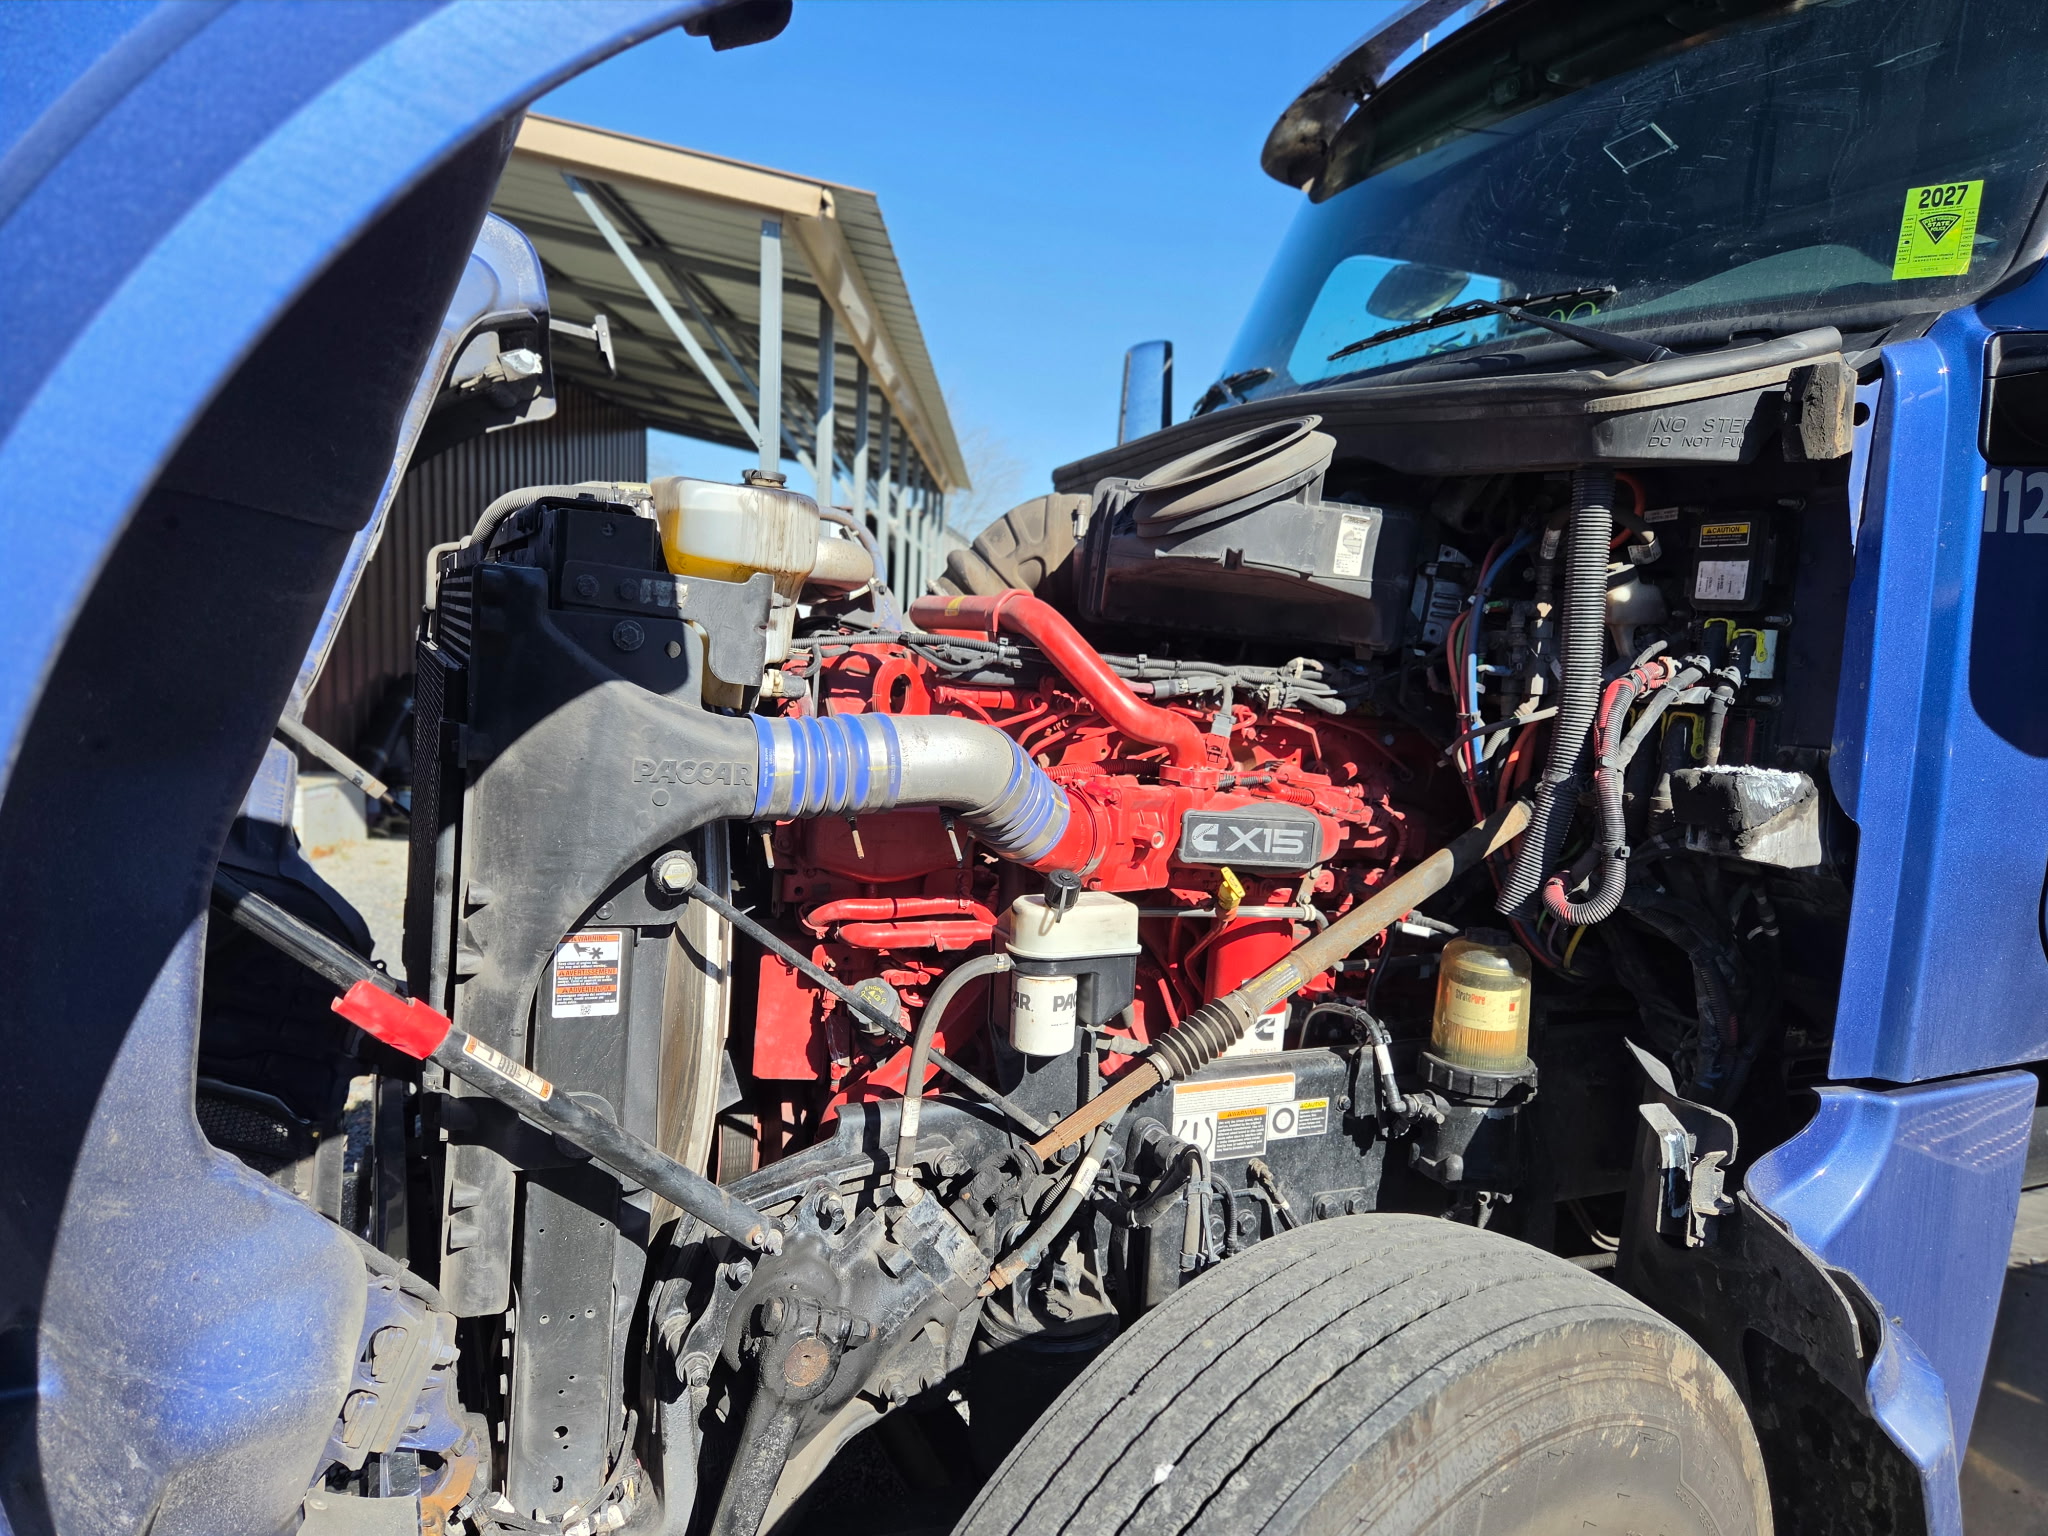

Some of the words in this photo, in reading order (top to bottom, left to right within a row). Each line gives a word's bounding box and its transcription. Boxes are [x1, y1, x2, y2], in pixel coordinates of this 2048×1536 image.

[1919, 184, 1968, 209] 2027
[1927, 220, 1951, 228] STATE
[1653, 416, 1687, 433] NO
[1648, 436, 1672, 448] DO
[1681, 436, 1714, 448] NOT
[1981, 468, 2048, 534] 112
[1712, 526, 1740, 534] CAUTION
[632, 759, 753, 786] PACCAR
[1225, 826, 1304, 854] X15
[578, 934, 608, 942] WARNING
[565, 968, 616, 976] AVERTISSEMENT
[1305, 1101, 1327, 1109] CAUTION
[1231, 1108, 1258, 1117] WARNING
